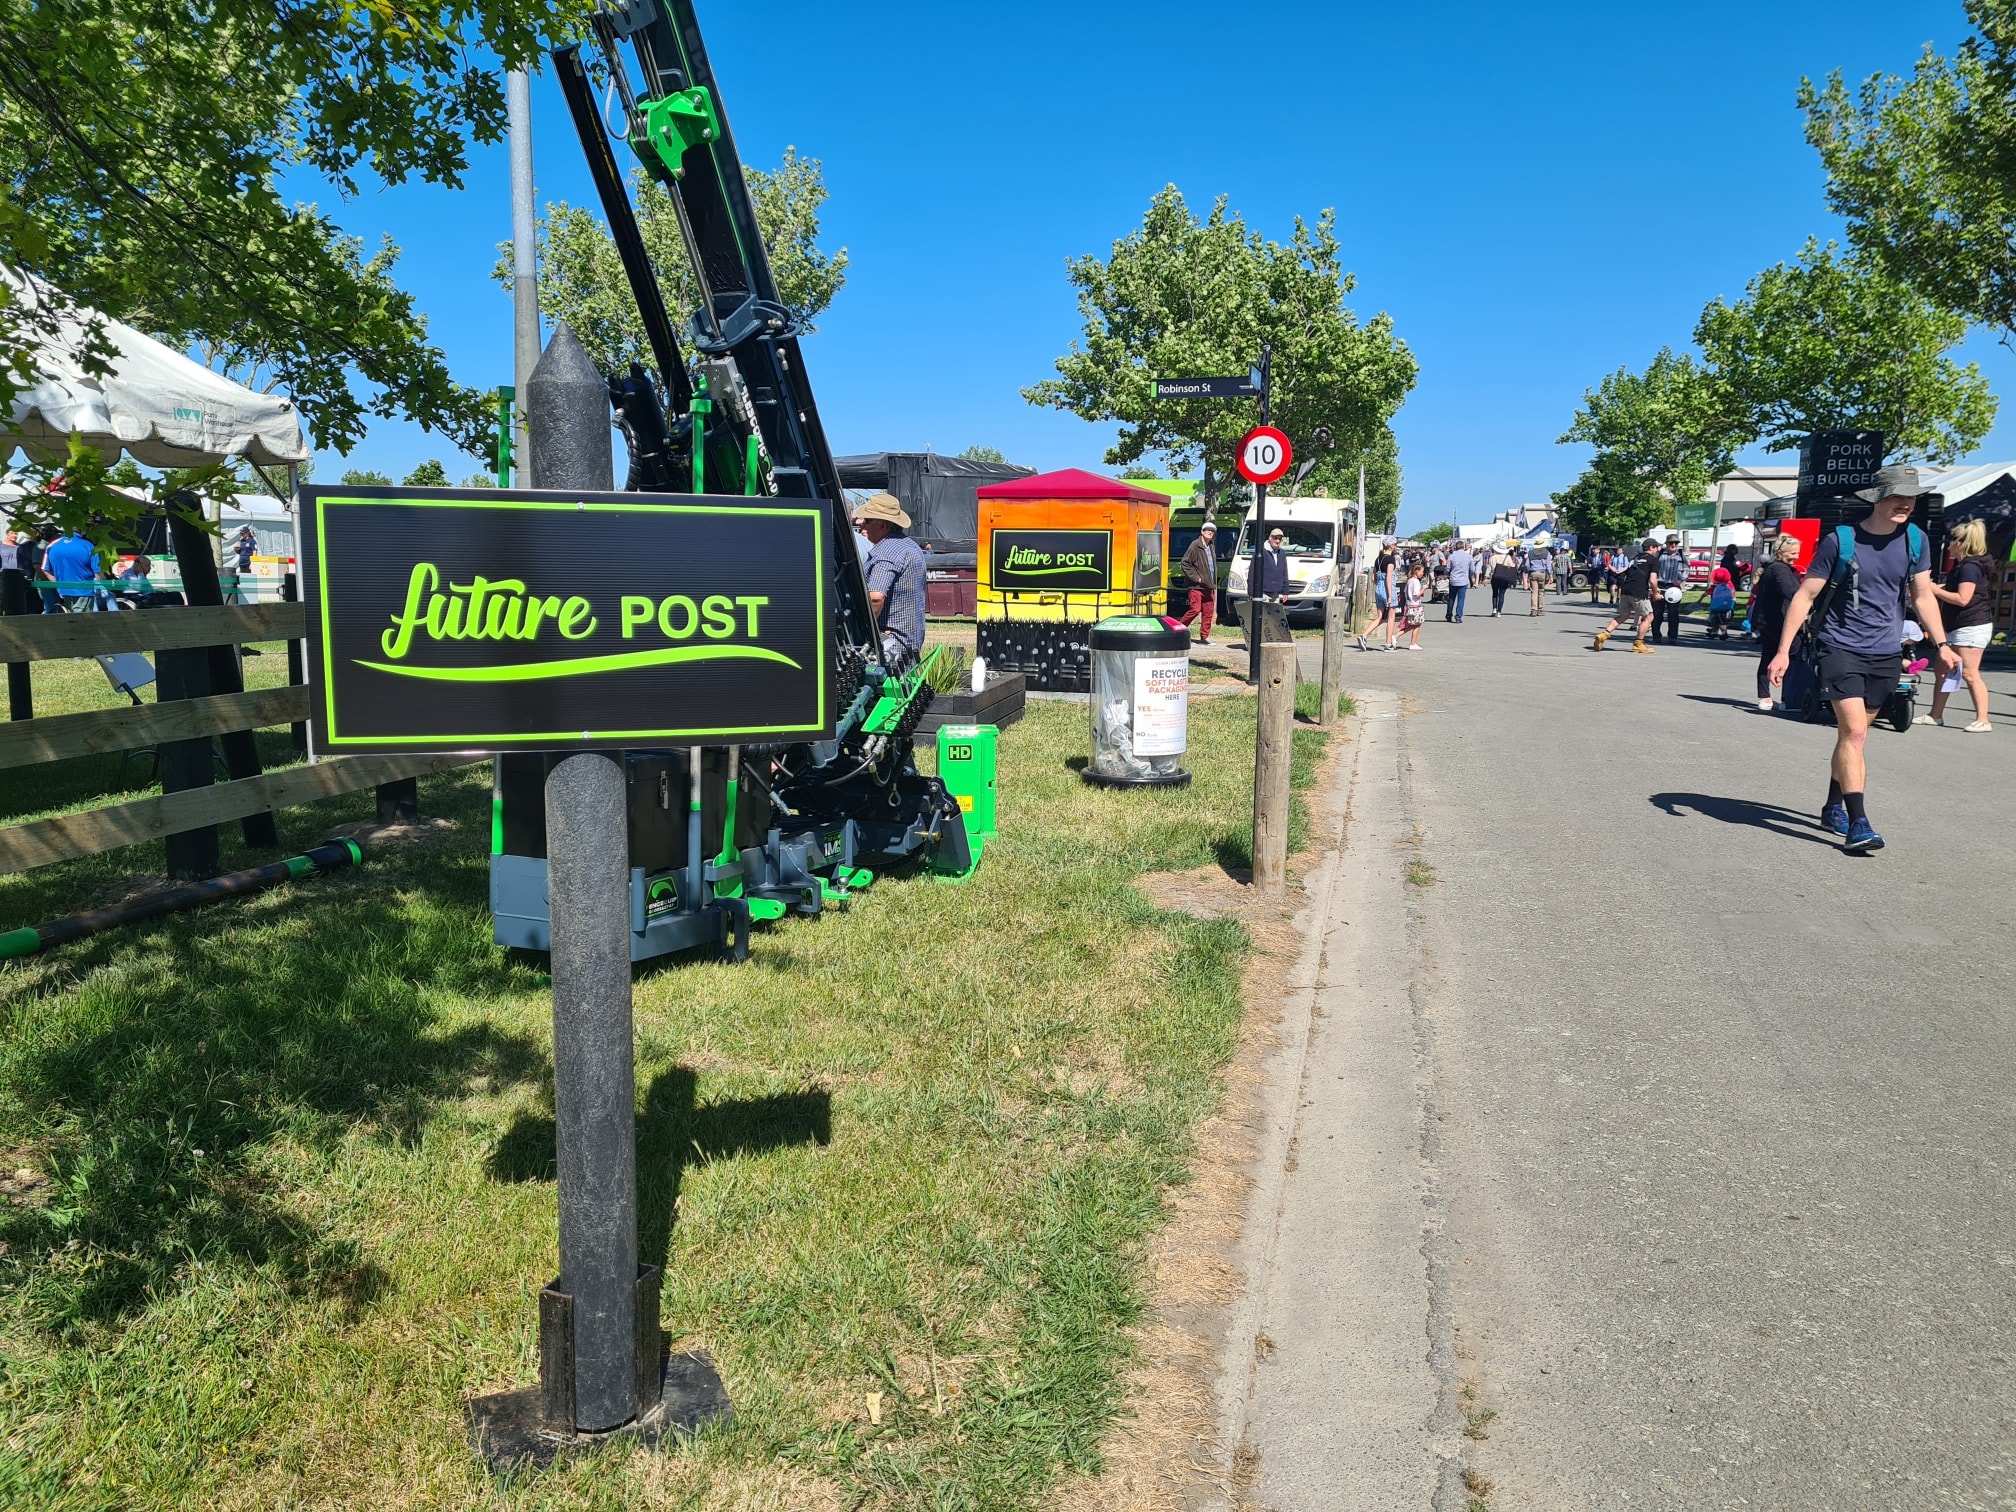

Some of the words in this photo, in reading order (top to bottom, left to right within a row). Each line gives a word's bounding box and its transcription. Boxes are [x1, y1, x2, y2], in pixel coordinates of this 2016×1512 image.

[1158, 383, 1200, 393] Robinson
[1201, 383, 1211, 392] St
[1252, 444, 1276, 465] 10
[1830, 444, 1872, 456] PORK
[1827, 459, 1874, 470] BELLY
[766, 470, 779, 493] 5.0
[1004, 545, 1052, 569] future
[1056, 553, 1095, 566] POST
[381, 562, 597, 659] future
[621, 594, 769, 640] POST
[1151, 669, 1187, 678] RECYCLE
[1145, 679, 1167, 687] SOFT
[1168, 677, 1187, 686] PLASTI
[1149, 686, 1188, 694] PACKAGIN
[949, 746, 971, 759] HD
